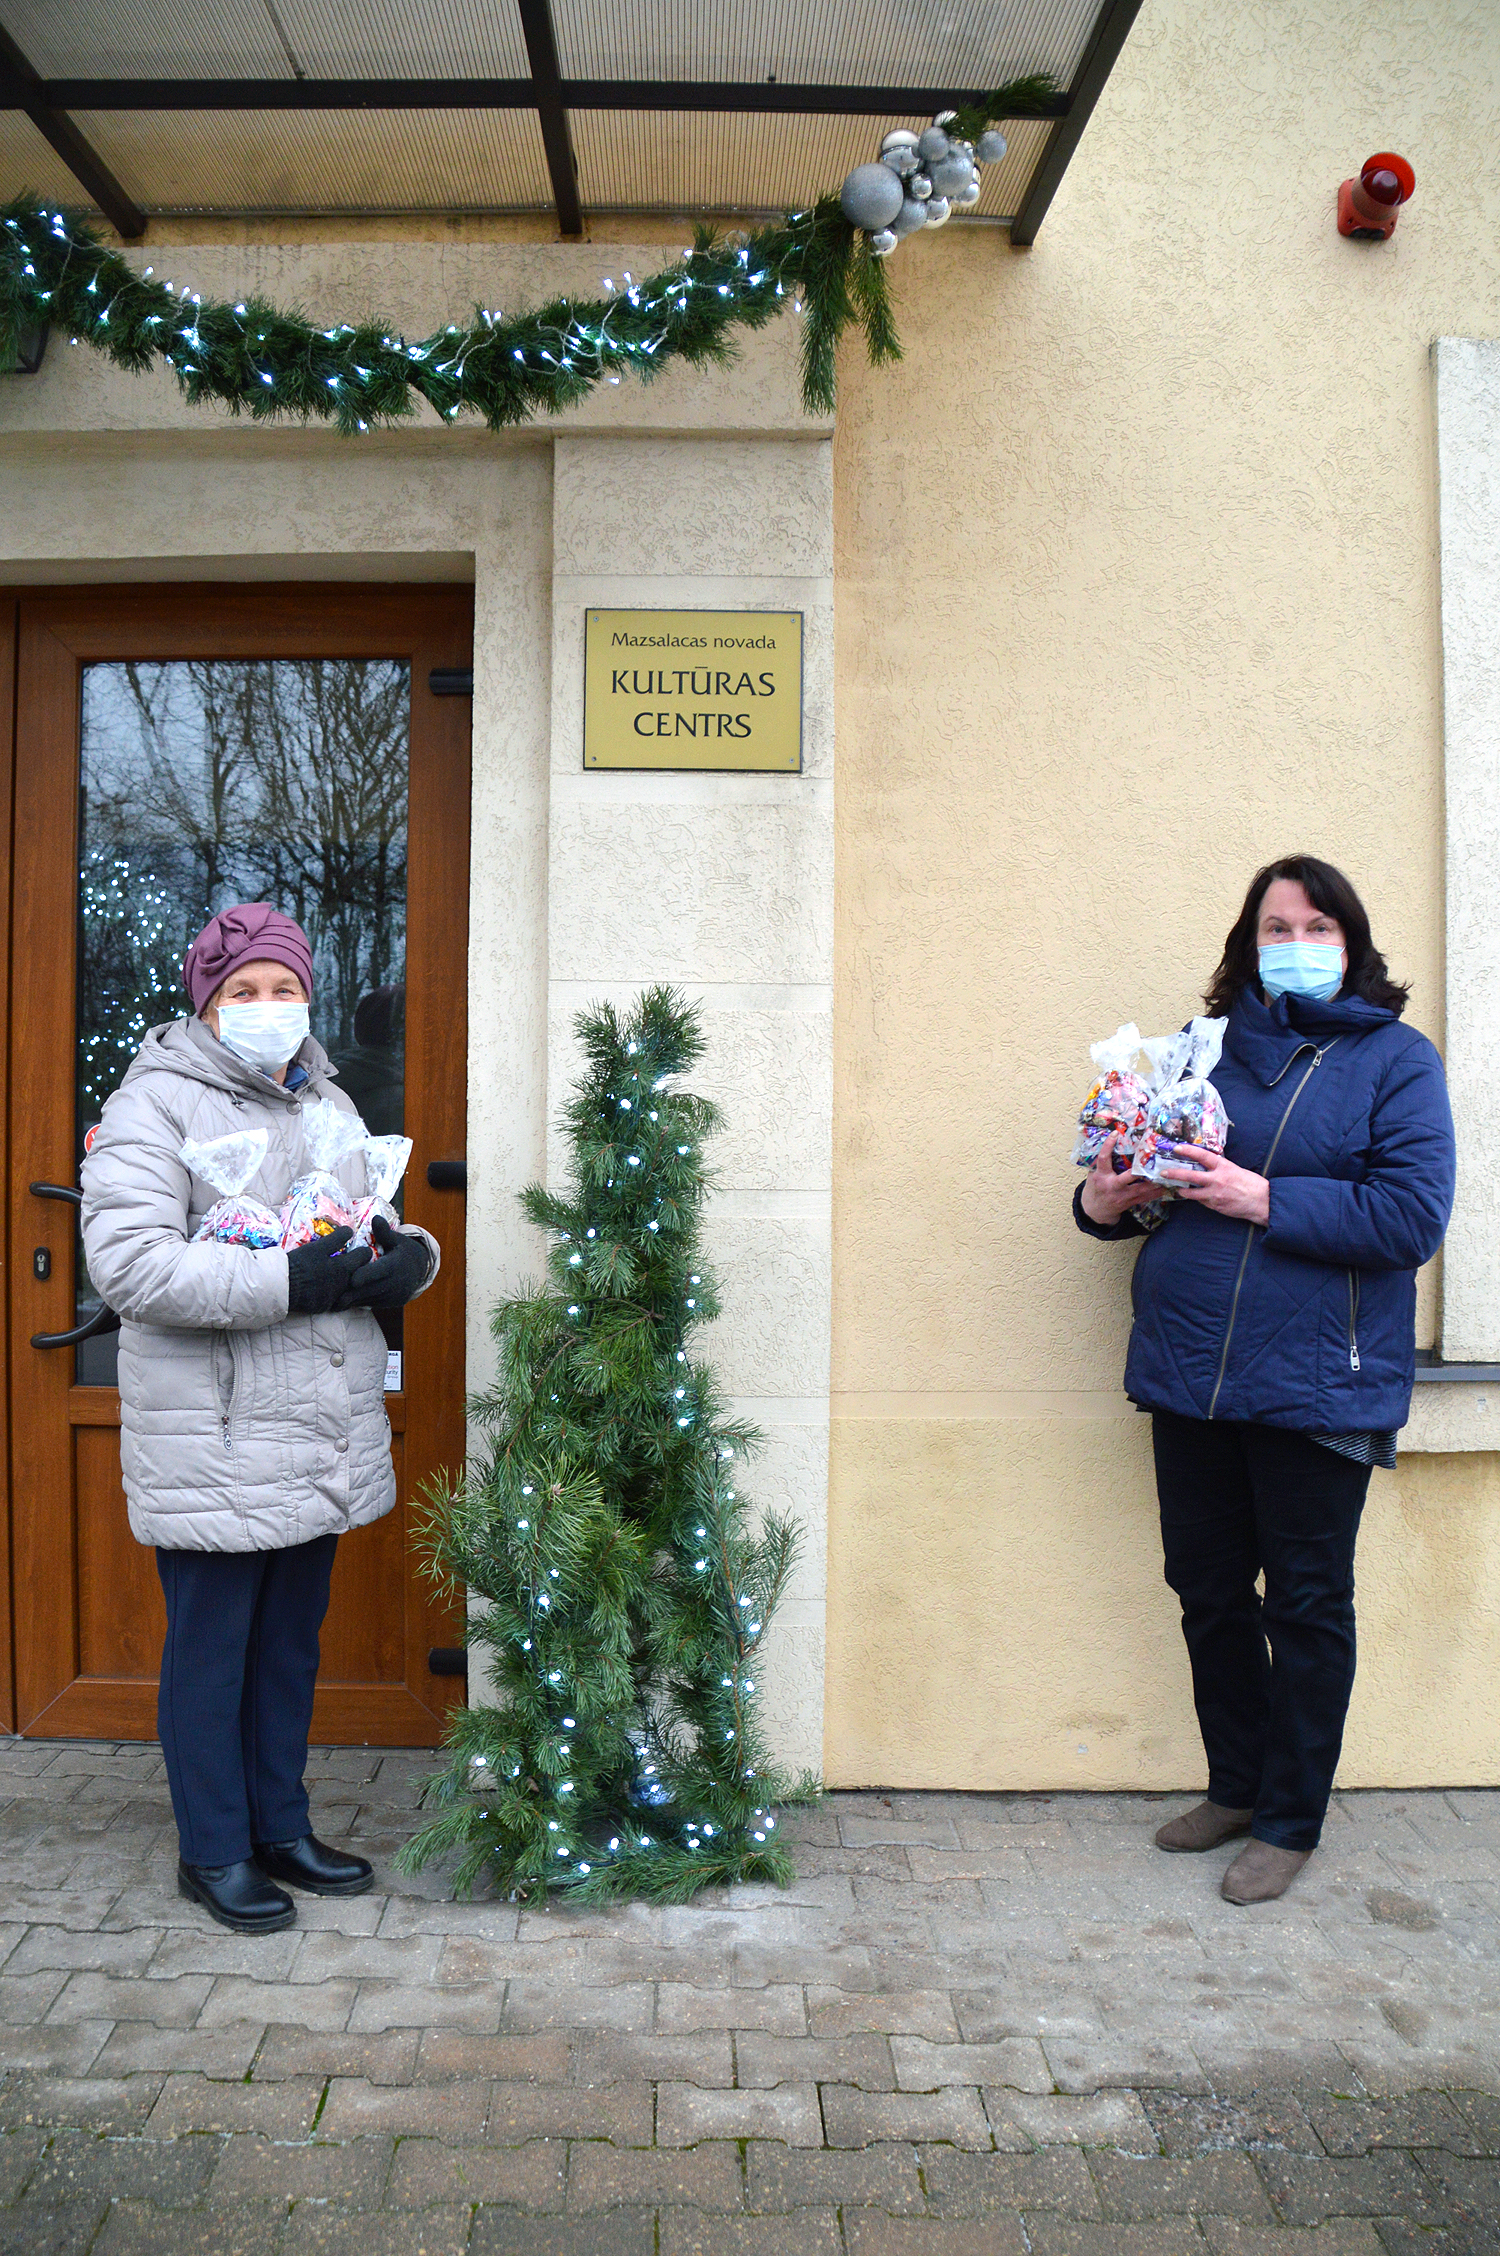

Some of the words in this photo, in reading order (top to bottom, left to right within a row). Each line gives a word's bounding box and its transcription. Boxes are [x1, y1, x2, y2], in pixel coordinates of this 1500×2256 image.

[611, 632, 708, 648] Mazsalacas
[713, 635, 777, 649] novada
[611, 666, 776, 697] KULTŪRAS
[633, 712, 752, 738] CENTRS
